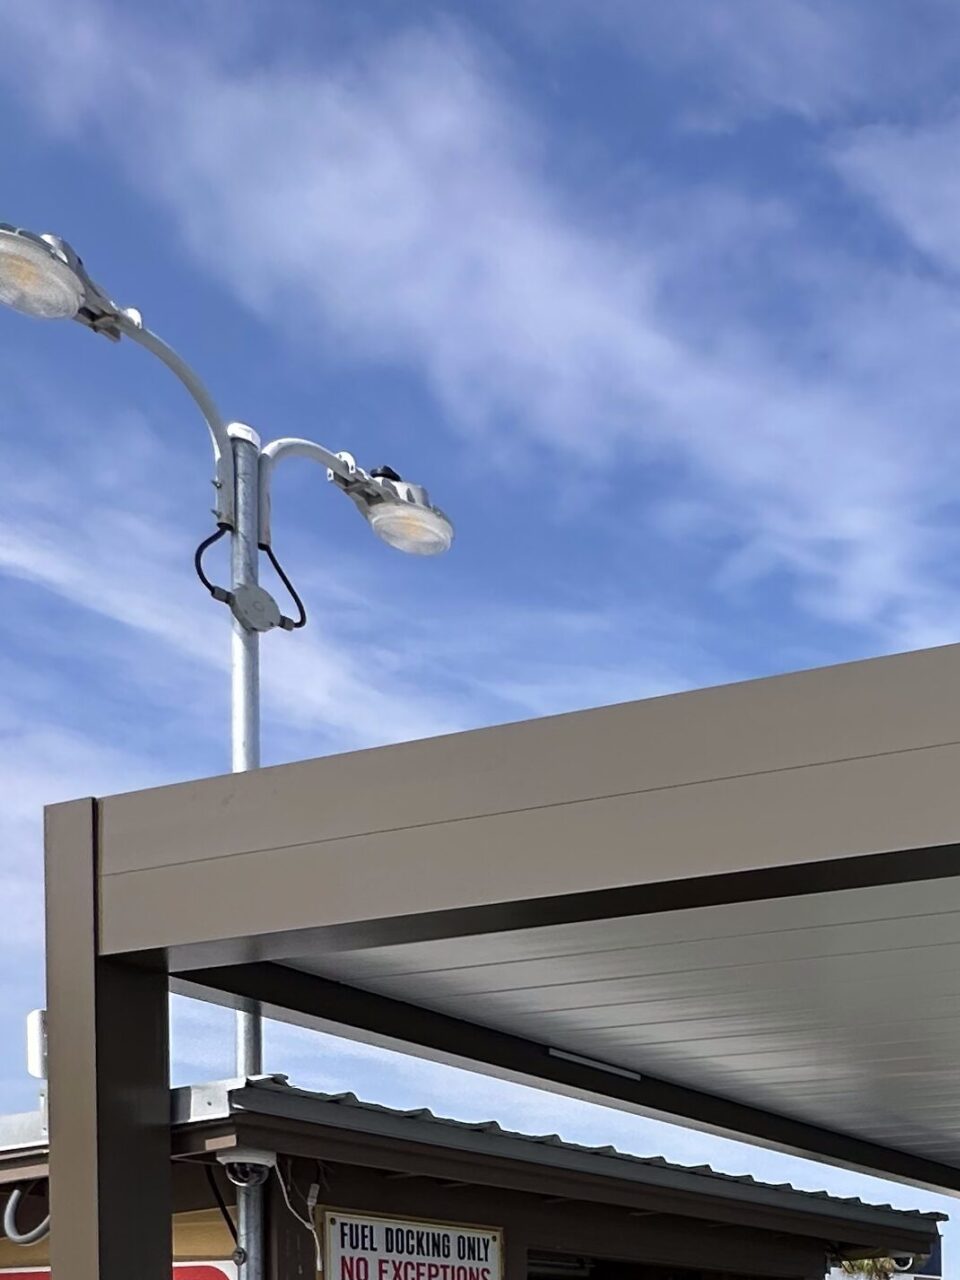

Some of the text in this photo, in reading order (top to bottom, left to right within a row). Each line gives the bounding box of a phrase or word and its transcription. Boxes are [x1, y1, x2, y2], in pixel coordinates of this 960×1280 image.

[340, 1222, 490, 1262] FUEL DOCKING ONLY
